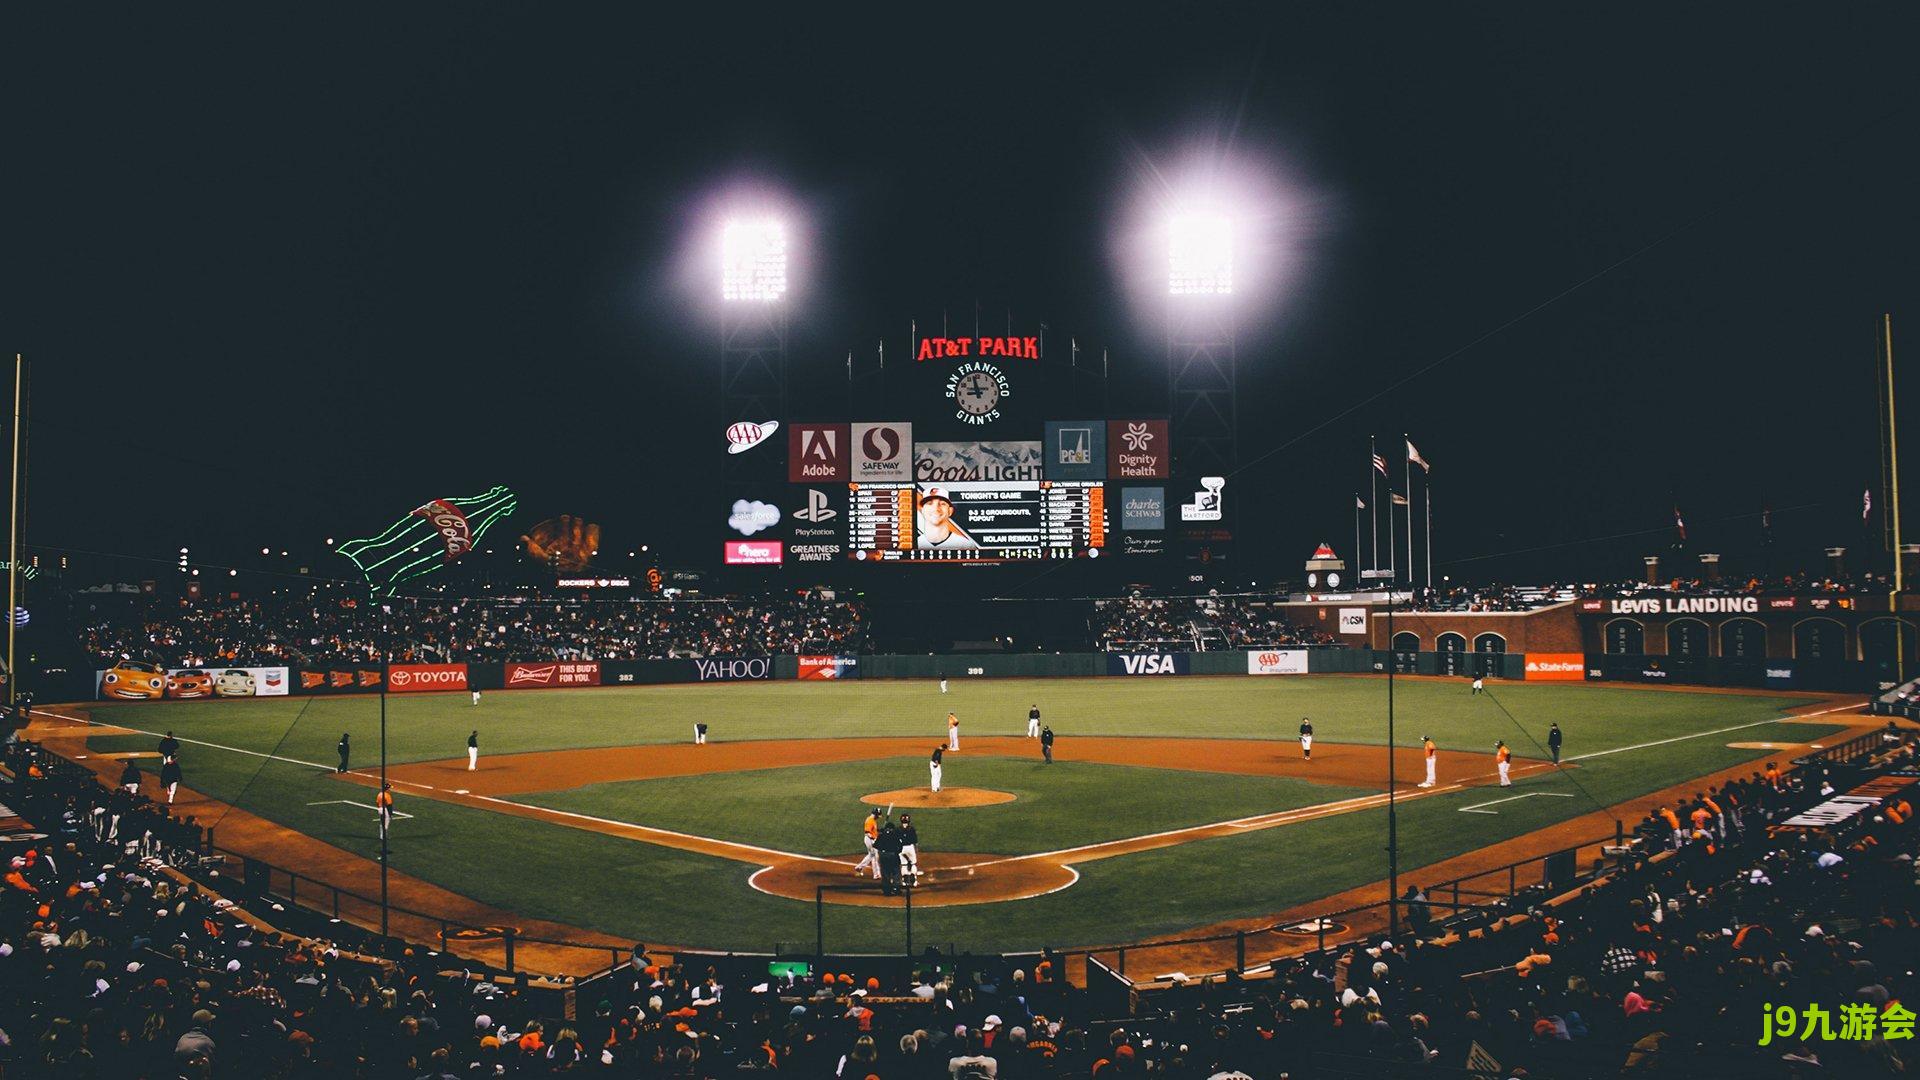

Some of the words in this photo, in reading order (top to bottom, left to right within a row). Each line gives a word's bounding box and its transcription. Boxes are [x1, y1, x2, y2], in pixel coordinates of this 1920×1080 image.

[917, 337, 972, 361] AT&T
[979, 337, 1038, 359] PARK
[945, 374, 960, 398] SAN
[958, 361, 1010, 397] FRANCISCO
[956, 409, 1000, 425] GIANTS
[1061, 450, 1089, 463] PG&E
[1119, 454, 1157, 467] Dignity
[802, 464, 836, 476] Adobe
[862, 462, 900, 470] SAFEWAY
[916, 458, 983, 481] Coors
[985, 465, 1042, 481] LIGHT
[1121, 467, 1156, 476] Health
[1125, 499, 1161, 509] charles
[734, 510, 774, 521] salesforce
[1125, 510, 1161, 518] SCHWAB
[795, 528, 834, 538] PlayStation
[790, 545, 840, 553] GREATNESS
[799, 553, 832, 561] AWAITS
[1666, 597, 1758, 613] LANDING
[1350, 616, 1364, 625] CSN
[800, 657, 817, 666] Bank
[818, 657, 826, 666] of
[826, 656, 856, 666] America
[1119, 654, 1176, 674] VISA
[559, 665, 576, 673] THIS
[576, 664, 598, 672] BUD'S
[694, 658, 770, 681] YAHOO!
[413, 672, 466, 683] TOYOTA
[514, 669, 551, 679] Budweiser
[559, 674, 574, 682] FOR
[575, 673, 590, 682] YOU.
